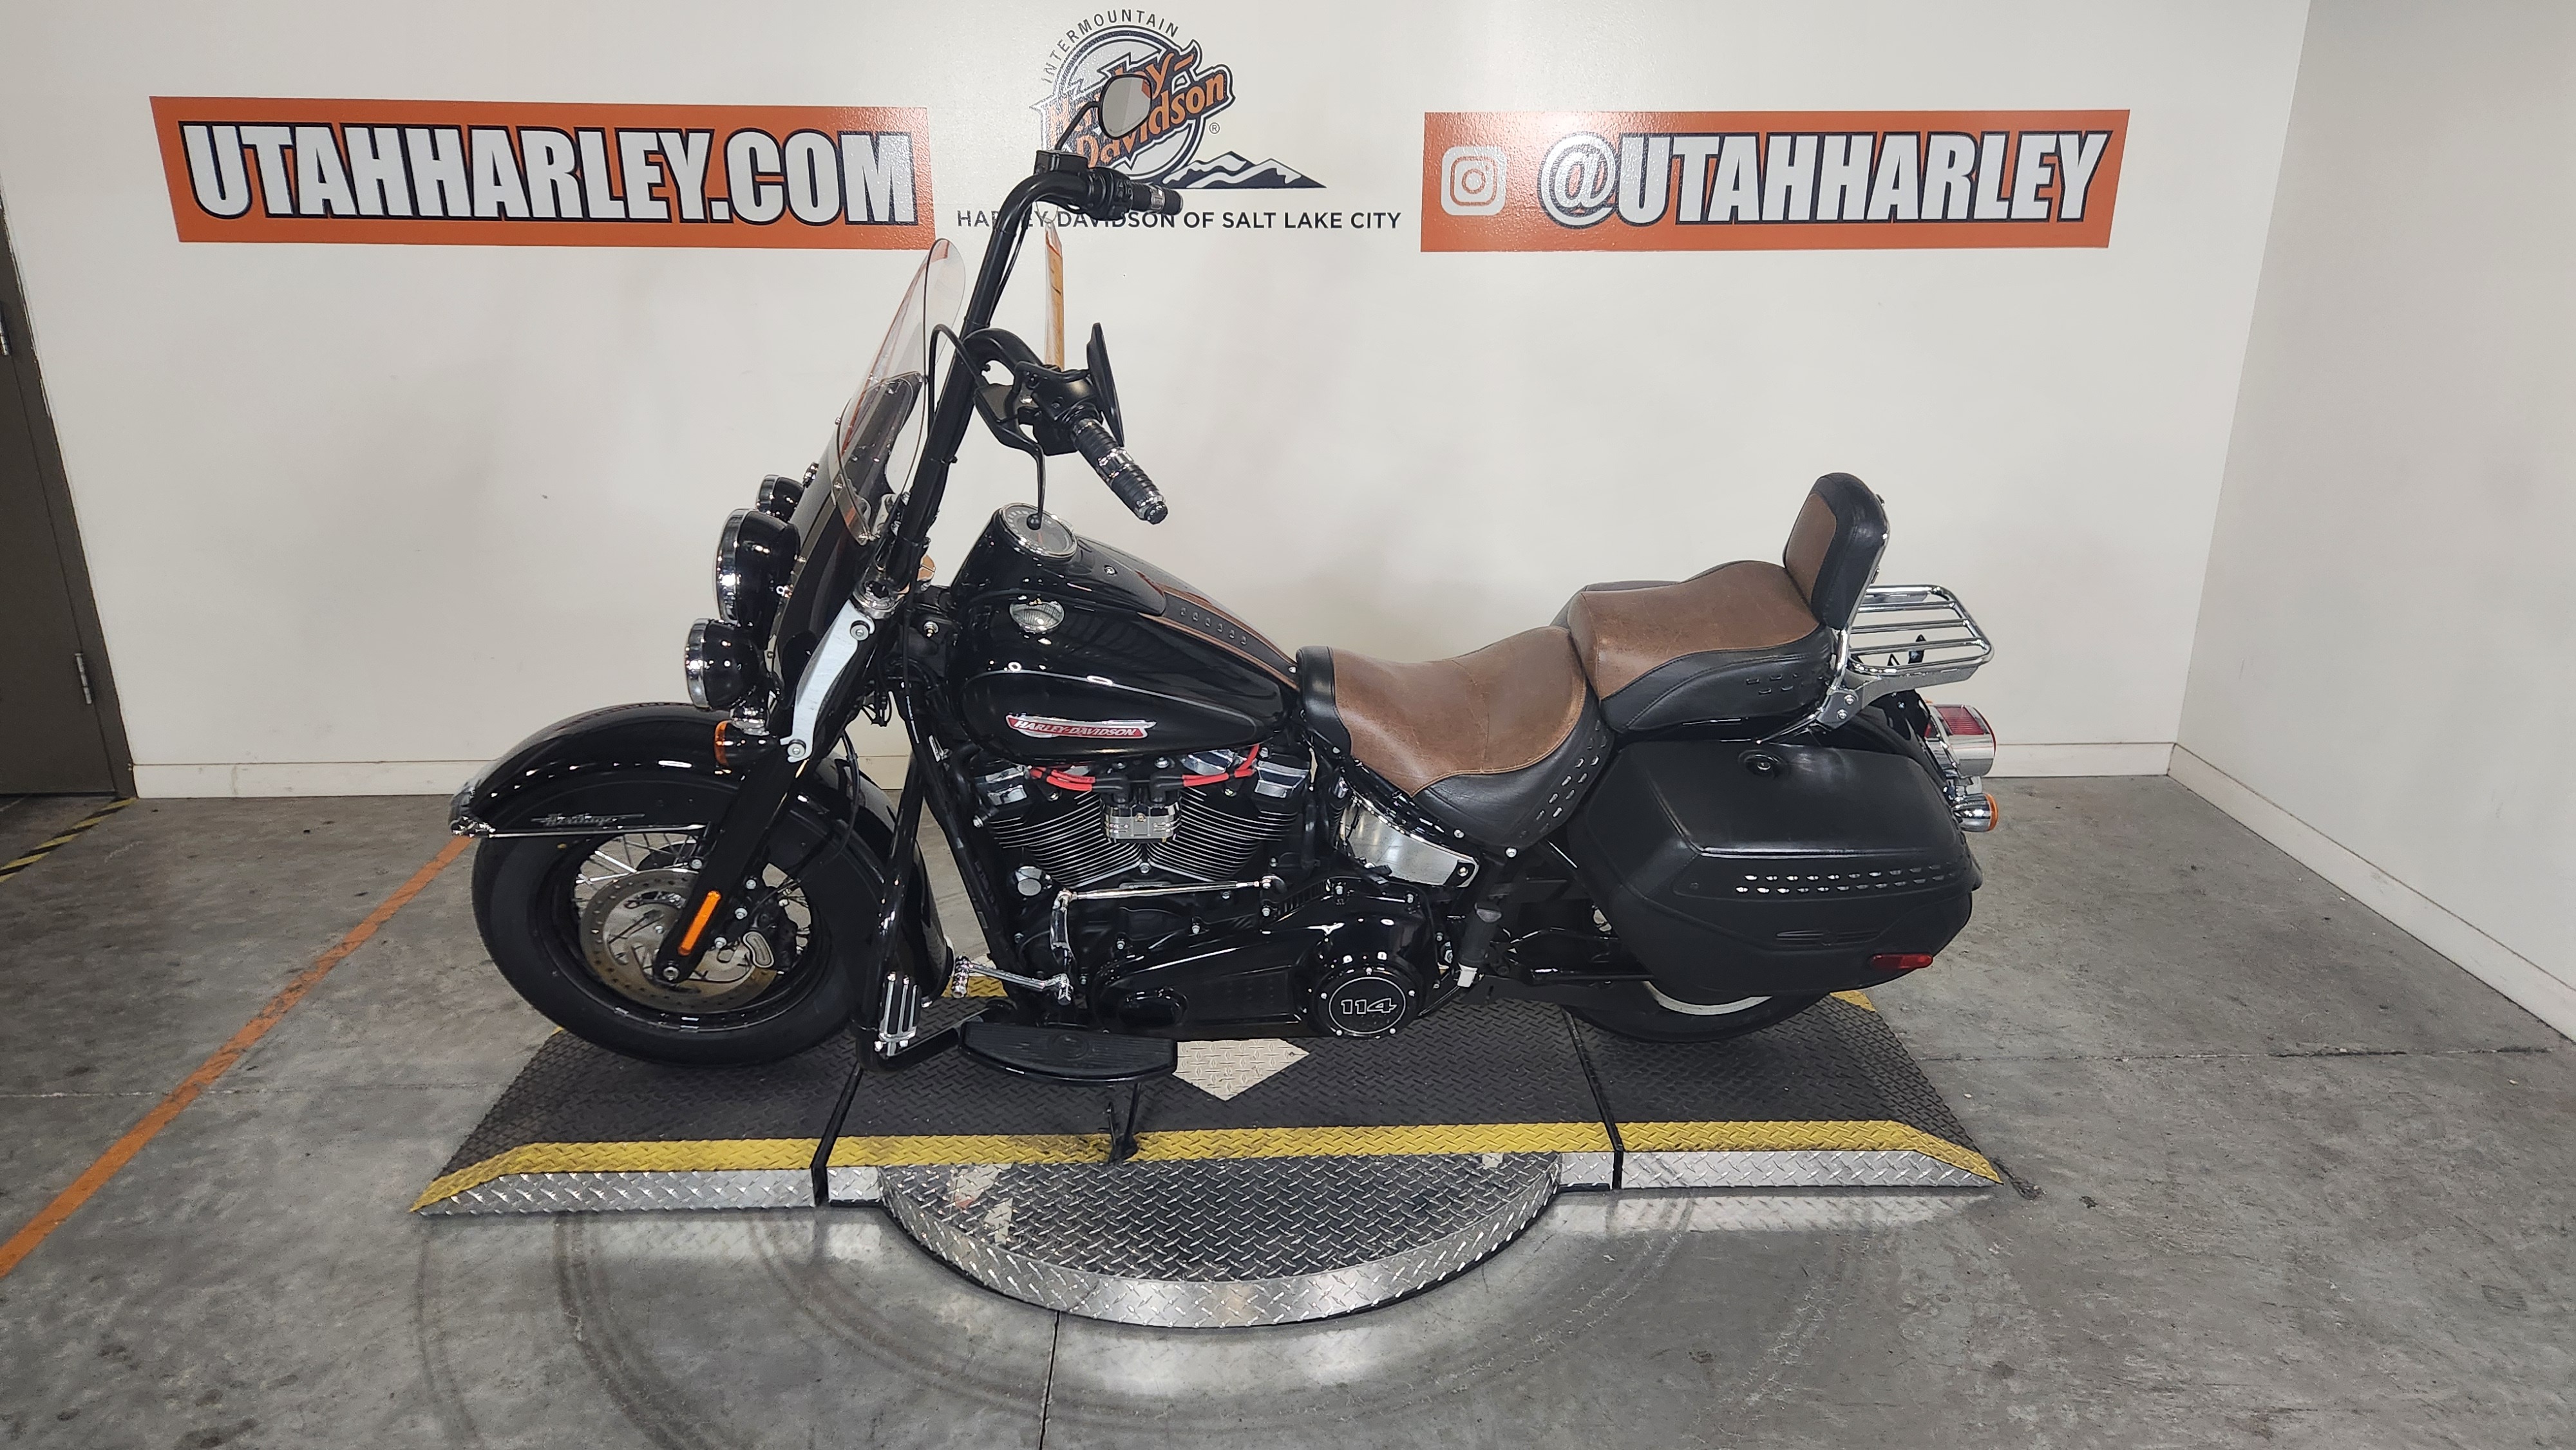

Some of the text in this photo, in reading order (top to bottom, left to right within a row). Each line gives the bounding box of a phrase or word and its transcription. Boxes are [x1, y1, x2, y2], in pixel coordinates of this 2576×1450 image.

[1041, 9, 1179, 84] INTERMOUNTAIN
[178, 120, 919, 225] UTAHHARLEY.COM
[1537, 129, 2115, 230] @UTAHHARLEY
[1183, 211, 1215, 229] OF
[1222, 211, 1276, 229] SALT
[1284, 211, 1343, 229] LAKE
[1350, 211, 1401, 229] CITY
[1013, 719, 1138, 737] HARLEY-DAVIDSON
[1340, 997, 1397, 1015] 114
